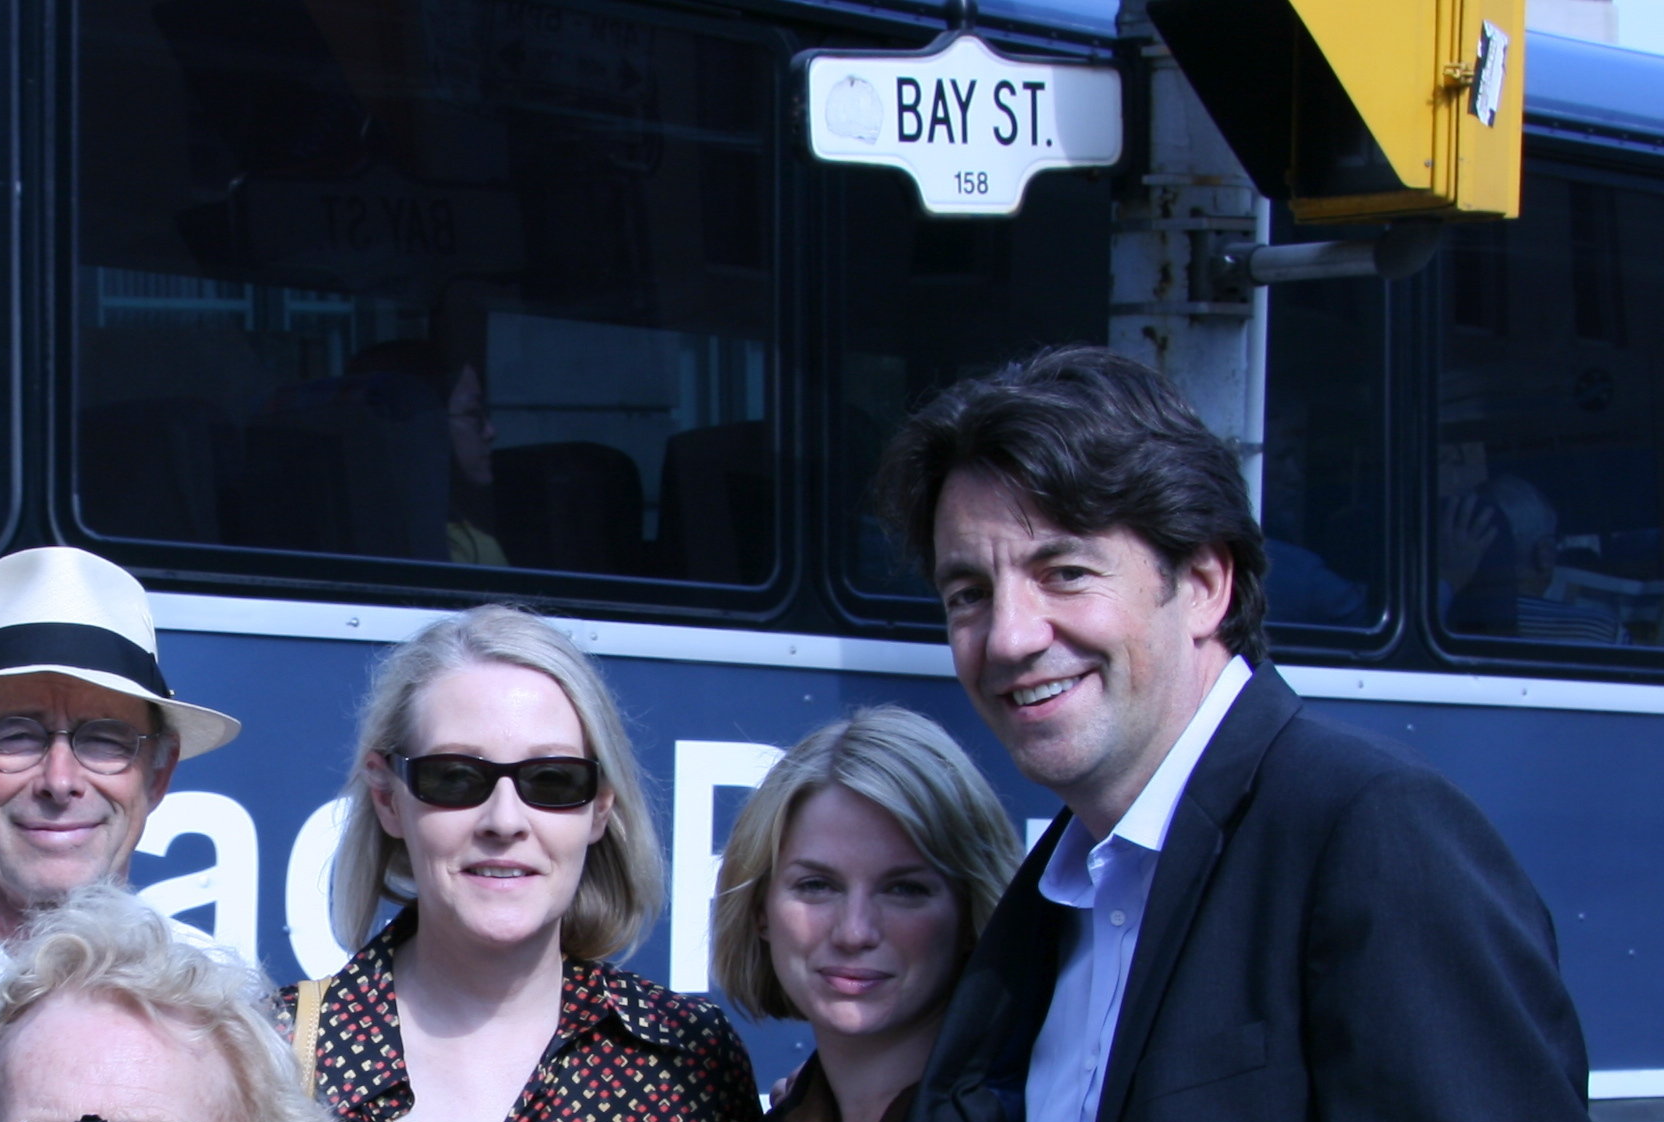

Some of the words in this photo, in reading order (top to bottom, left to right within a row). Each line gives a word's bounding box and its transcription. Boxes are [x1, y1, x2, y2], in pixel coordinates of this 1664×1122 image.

[896, 77, 977, 144] BAY
[993, 80, 1053, 147] ST.
[954, 172, 989, 194] 158
